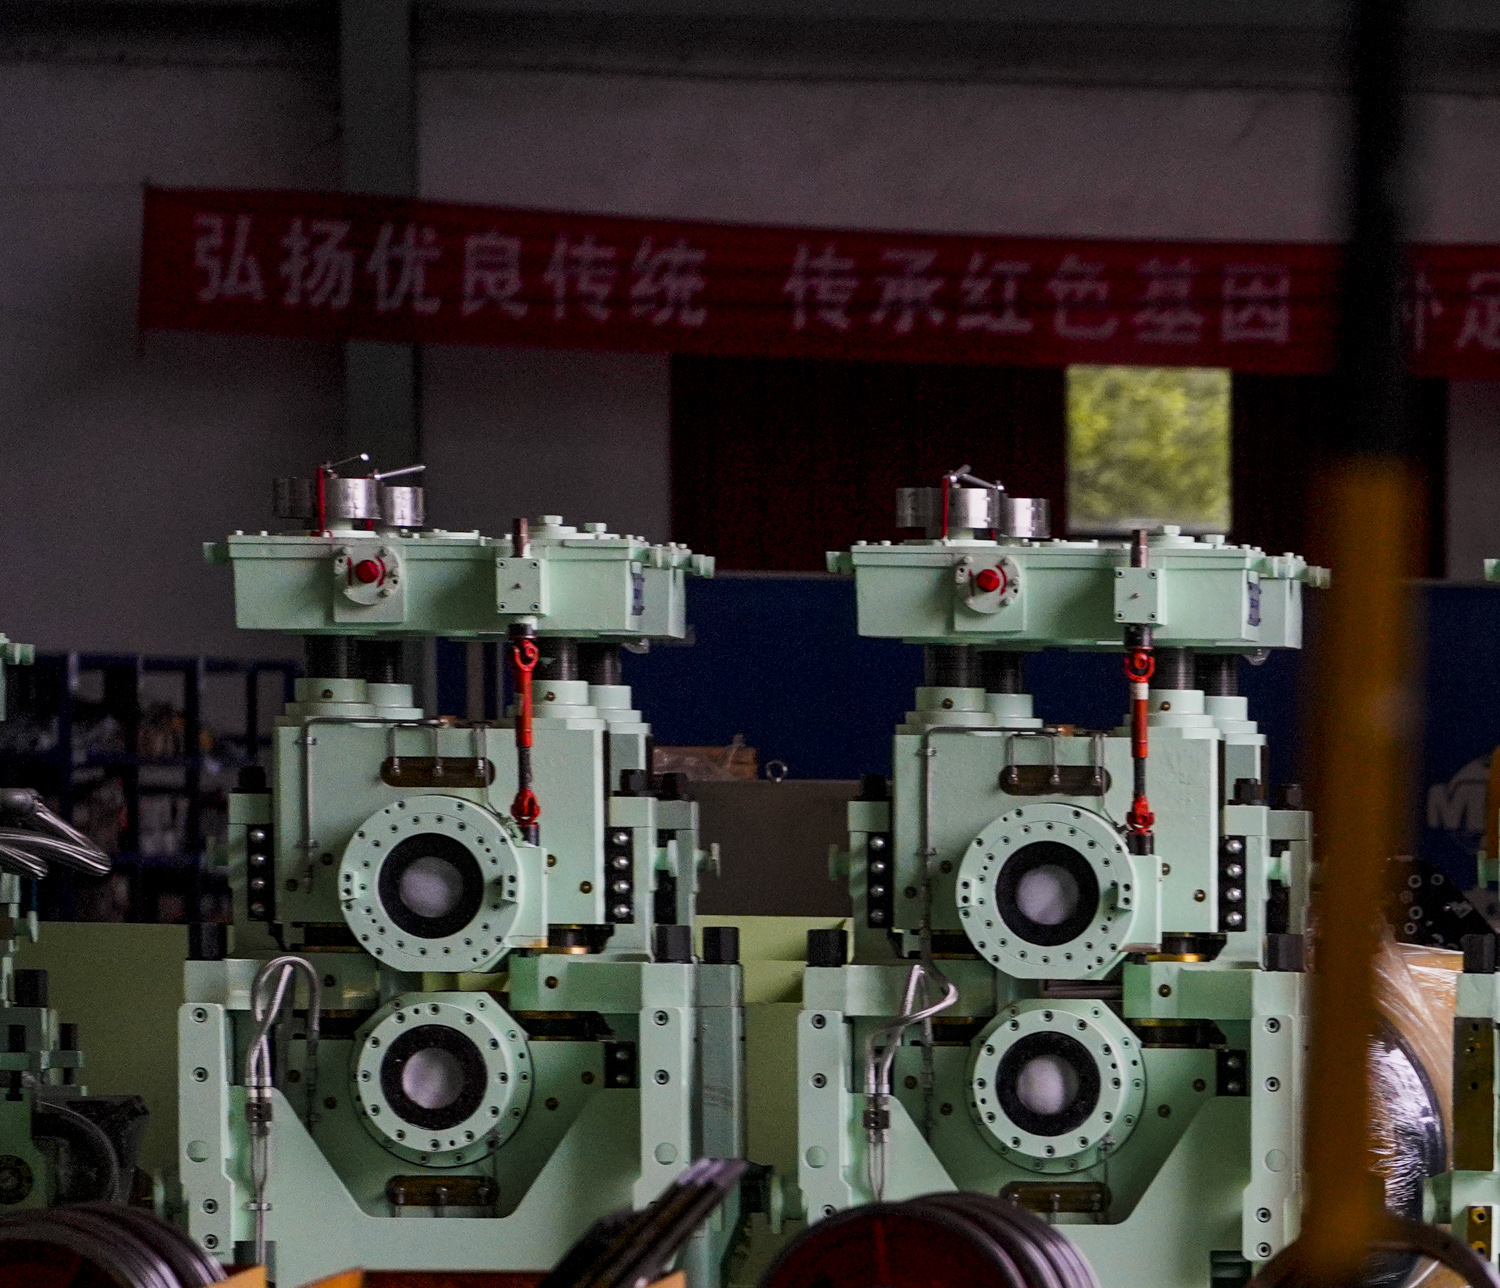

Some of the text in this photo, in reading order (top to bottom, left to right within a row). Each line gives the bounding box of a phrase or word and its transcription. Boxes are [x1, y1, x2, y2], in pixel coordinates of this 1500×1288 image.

[195, 211, 707, 327] 弘扬优良传统
[781, 241, 1292, 345] 传承红色基因
